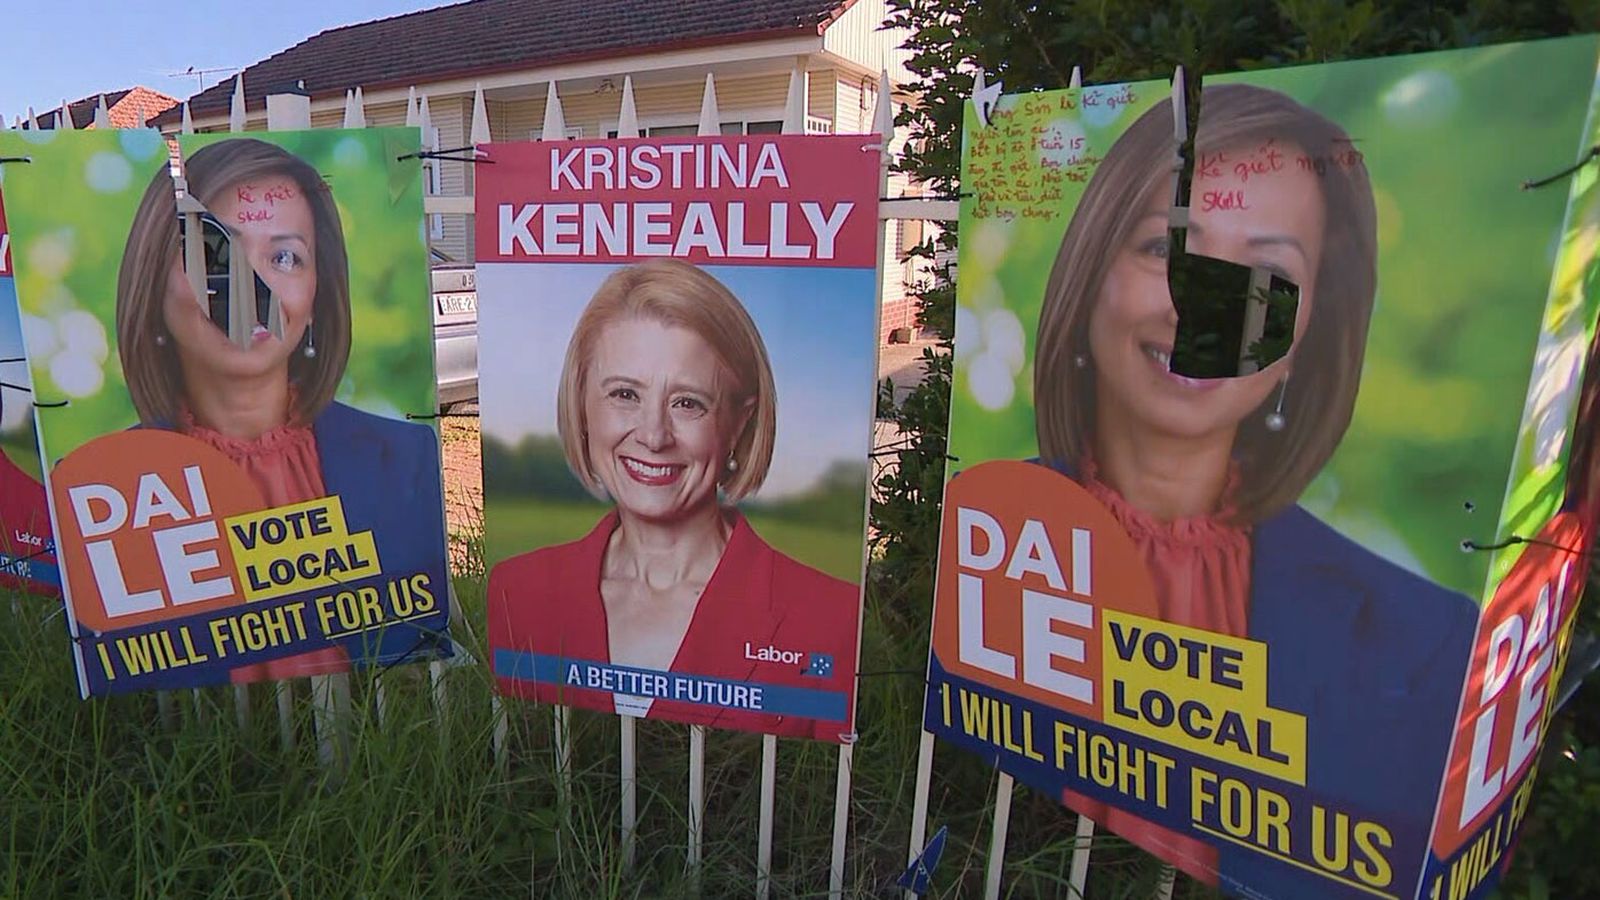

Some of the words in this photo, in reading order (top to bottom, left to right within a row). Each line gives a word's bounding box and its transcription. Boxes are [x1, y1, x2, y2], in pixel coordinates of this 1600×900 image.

[550, 143, 789, 190] KRISTINA
[1070, 137, 1086, 150] 15
[499, 202, 855, 260] KENEALLY
[69, 465, 213, 538] DAI
[231, 506, 332, 551] VOTE
[85, 519, 236, 619] LE
[246, 544, 370, 592] LOCAL
[957, 506, 1092, 597] DAI
[96, 642, 117, 681] I
[116, 626, 208, 677] WILL
[209, 601, 309, 659] FIGHT
[315, 587, 384, 636] FOR
[387, 574, 435, 618] US
[744, 642, 803, 665] Labor
[957, 572, 1094, 705] LE
[1108, 620, 1244, 691] VOTE
[1480, 559, 1573, 708] DAI
[566, 663, 583, 686] A
[586, 667, 669, 699] BETTER
[674, 679, 764, 710] FUTURE
[1113, 678, 1290, 765] LOCAL
[1459, 638, 1556, 831] LE
[941, 682, 952, 727] I
[959, 687, 1044, 763] WILL
[1054, 720, 1176, 809] FIGHT
[1190, 766, 1292, 855] FOR
[1310, 804, 1394, 888] US
[1448, 813, 1503, 900] WILL
